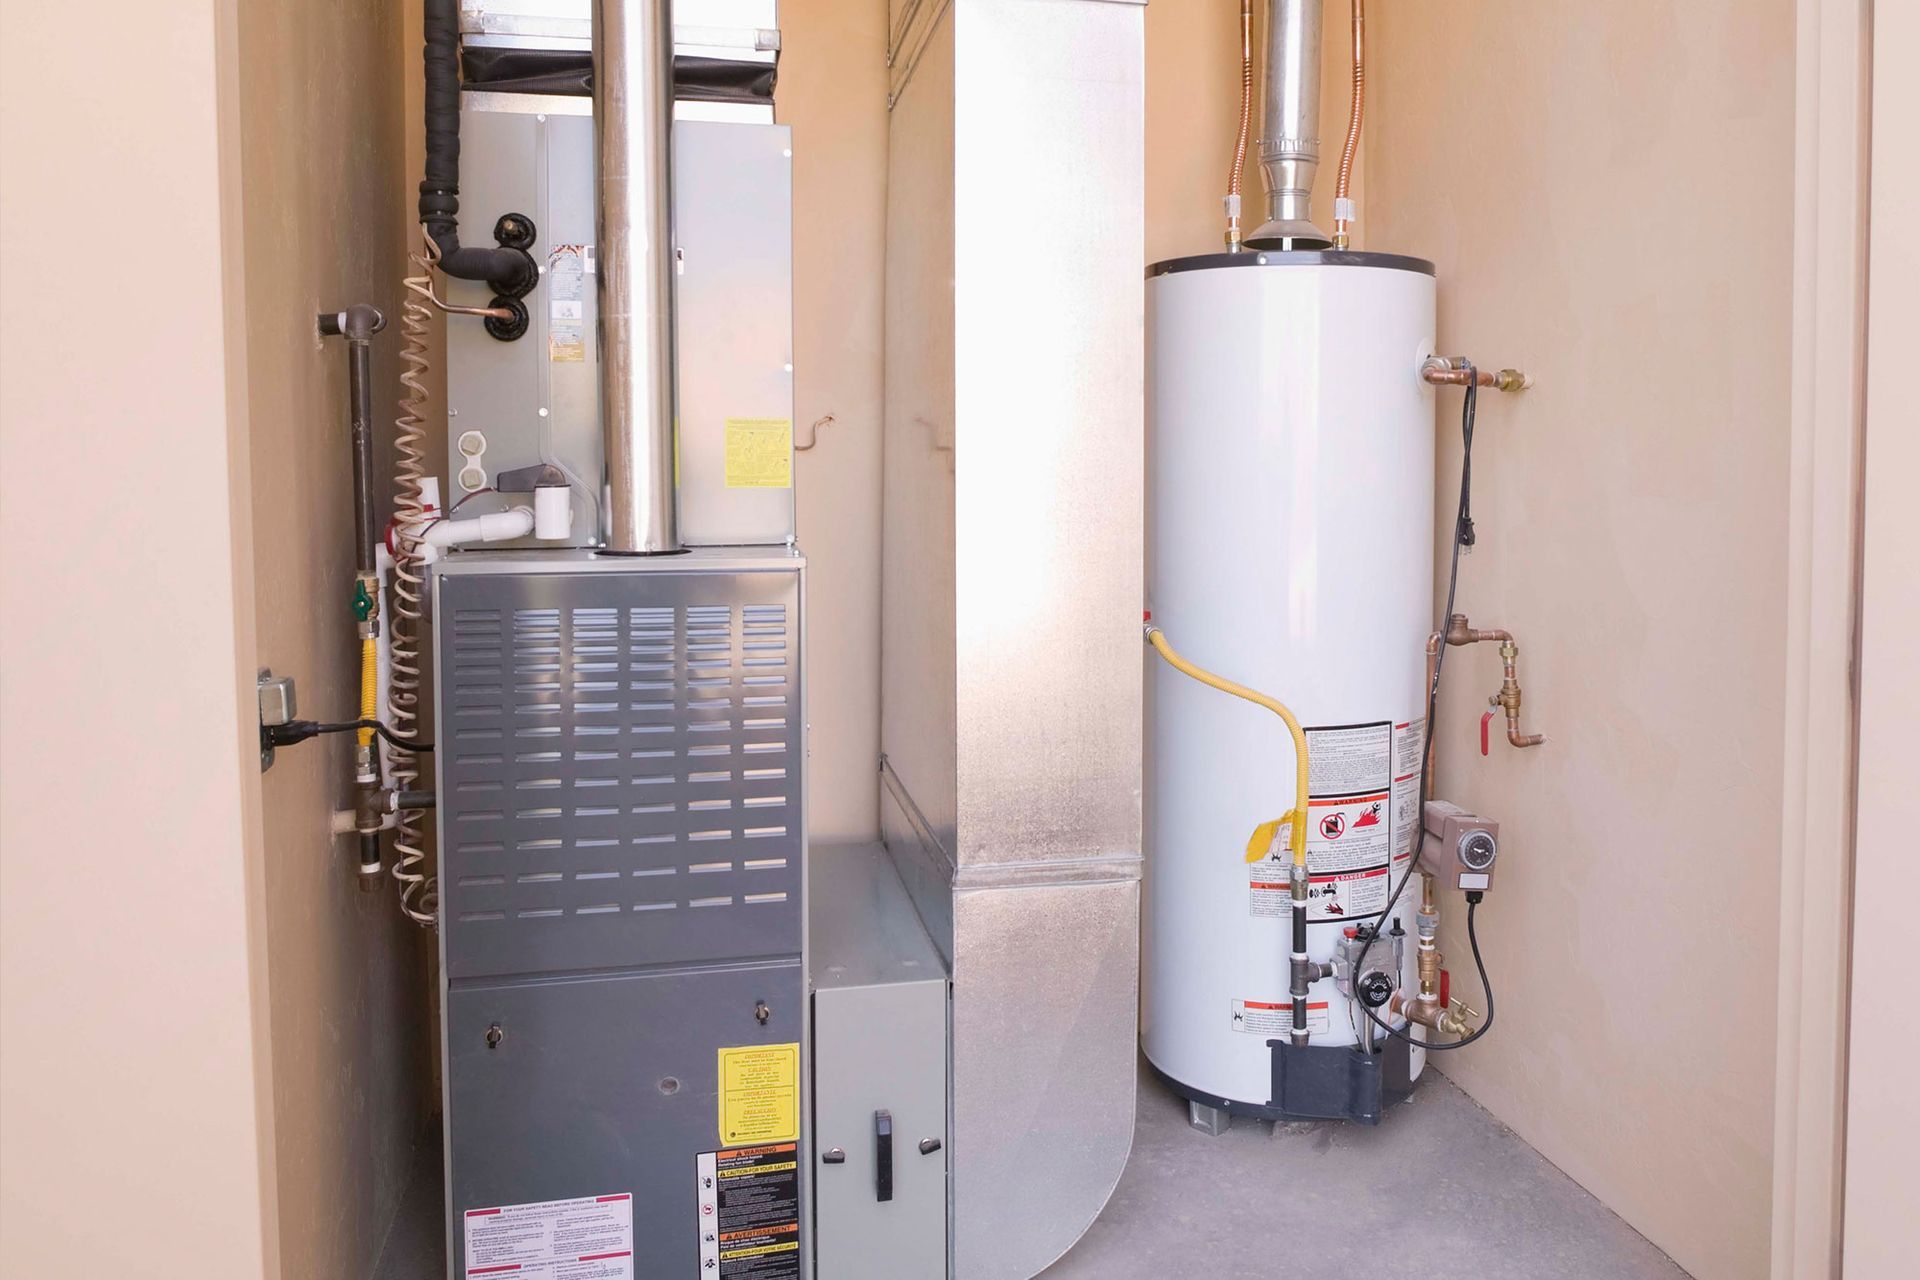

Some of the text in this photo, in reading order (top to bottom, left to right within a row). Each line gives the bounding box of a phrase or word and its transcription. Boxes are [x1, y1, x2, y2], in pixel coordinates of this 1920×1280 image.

[1340, 797, 1368, 805] WARNING
[1340, 873, 1365, 881] DANGER
[744, 1147, 777, 1156] WARNING
[733, 1225, 791, 1239] AVERTISSEMENT
